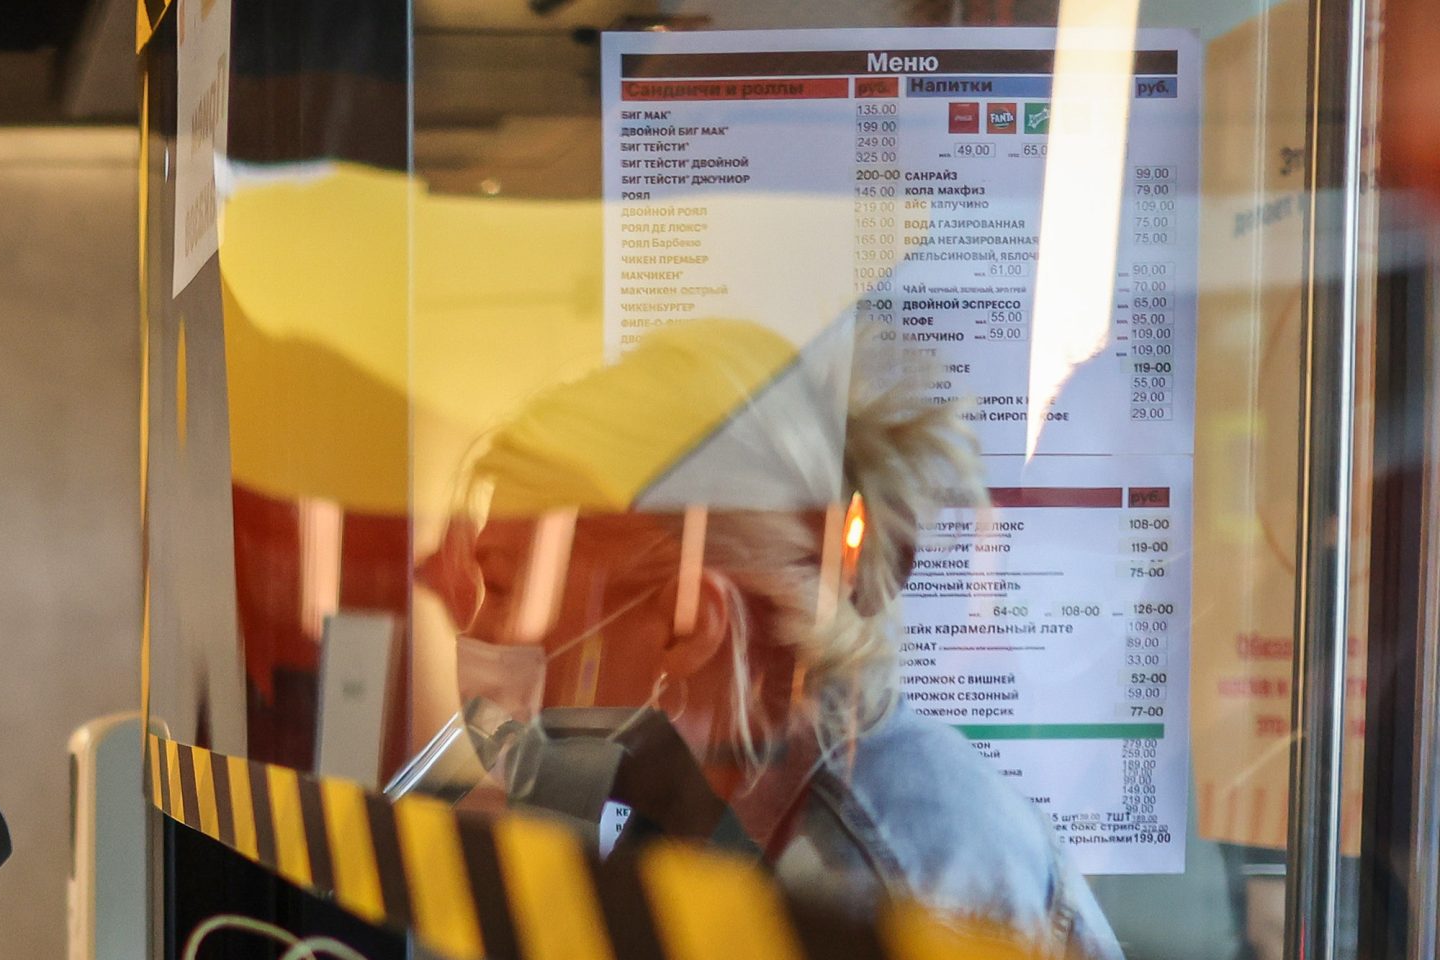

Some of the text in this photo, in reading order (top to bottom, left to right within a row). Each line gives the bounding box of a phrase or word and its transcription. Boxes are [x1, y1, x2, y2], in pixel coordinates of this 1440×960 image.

[867, 52, 939, 73] Меню
[911, 79, 992, 93] Напитки
[1137, 81, 1169, 96] руб.
[622, 111, 641, 120] БИГ
[622, 126, 675, 137] ДВОЙНОЙ
[679, 127, 698, 136] БИГ
[622, 143, 641, 151] БИГ
[622, 160, 642, 168] БИГ
[691, 157, 749, 169] ДВОЙНОЙ
[856, 170, 900, 181] 200-00
[905, 170, 958, 180] САНРАЙЗ
[1136, 168, 1170, 180] 99,00
[622, 176, 642, 184] БИГ
[691, 175, 750, 186] ДЖУНИОР
[905, 186, 985, 197] кола макфиз
[1136, 184, 1170, 196] 79,00
[622, 192, 650, 200] РОЯЛ
[904, 200, 989, 211] айс капучино
[621, 205, 707, 218] ДВОЙНОЙ РОЯЛ
[622, 224, 650, 232] РОЯЛ
[652, 224, 666, 234] ДЕ
[904, 219, 1025, 230] ВОДА ГАЗИРОВАННАЯ
[622, 238, 701, 248] РОЯЛ Барбекю
[904, 236, 1039, 246] ВОДА НЕГАЗИРОВАННАЯ
[622, 255, 709, 264] ЧИКЕН ПРЕМЬЕР
[904, 250, 1040, 263] АПЕЛЬСИНОВЫЙ, ЯБЛОЧ
[903, 283, 926, 294] ЧАЙ
[621, 303, 695, 312] ЧИКЕНБУРГЕР
[903, 299, 1021, 312] ДВОЙНОЙ ЭСПРЕССО
[1134, 298, 1166, 310] 65,00
[903, 316, 934, 326] КОФЕ
[991, 312, 1022, 324] 55,00
[1132, 314, 1165, 326] 95,00
[903, 332, 964, 342] КАПУЧИНО
[1132, 328, 1170, 340] 109,00
[1132, 345, 1170, 357] 109,00
[1134, 362, 1172, 373] 119-00
[990, 412, 1027, 422] СИРОП
[1042, 412, 1068, 422] ОФЕ
[992, 522, 1024, 531] ЛЮКС
[1130, 520, 1169, 530] 108-00
[975, 544, 1010, 554] манго
[1132, 542, 1168, 552] 119-00
[910, 560, 969, 570] ОРОЖЕНОЕ
[1130, 568, 1164, 578] 75-00
[966, 580, 1020, 590] КОКТЕЙЛЬ
[994, 606, 1028, 616] 64-00
[1061, 606, 1100, 616] 108-00
[1134, 604, 1173, 614] 126-00
[935, 623, 1036, 636] карамельный
[1040, 623, 1073, 634] лате
[900, 642, 938, 652] ДОНАТ
[1127, 654, 1159, 666] 33,00
[900, 674, 1015, 684] ПИРОЖОК С ВИШНЕЙ
[1131, 674, 1166, 684] 52-00
[958, 690, 1019, 701] СЕЗОННЫЙ
[1128, 688, 1160, 700] 59,00
[971, 707, 1014, 718] персик
[1130, 706, 1164, 716] 77-00
[1069, 833, 1132, 844] крыльями
